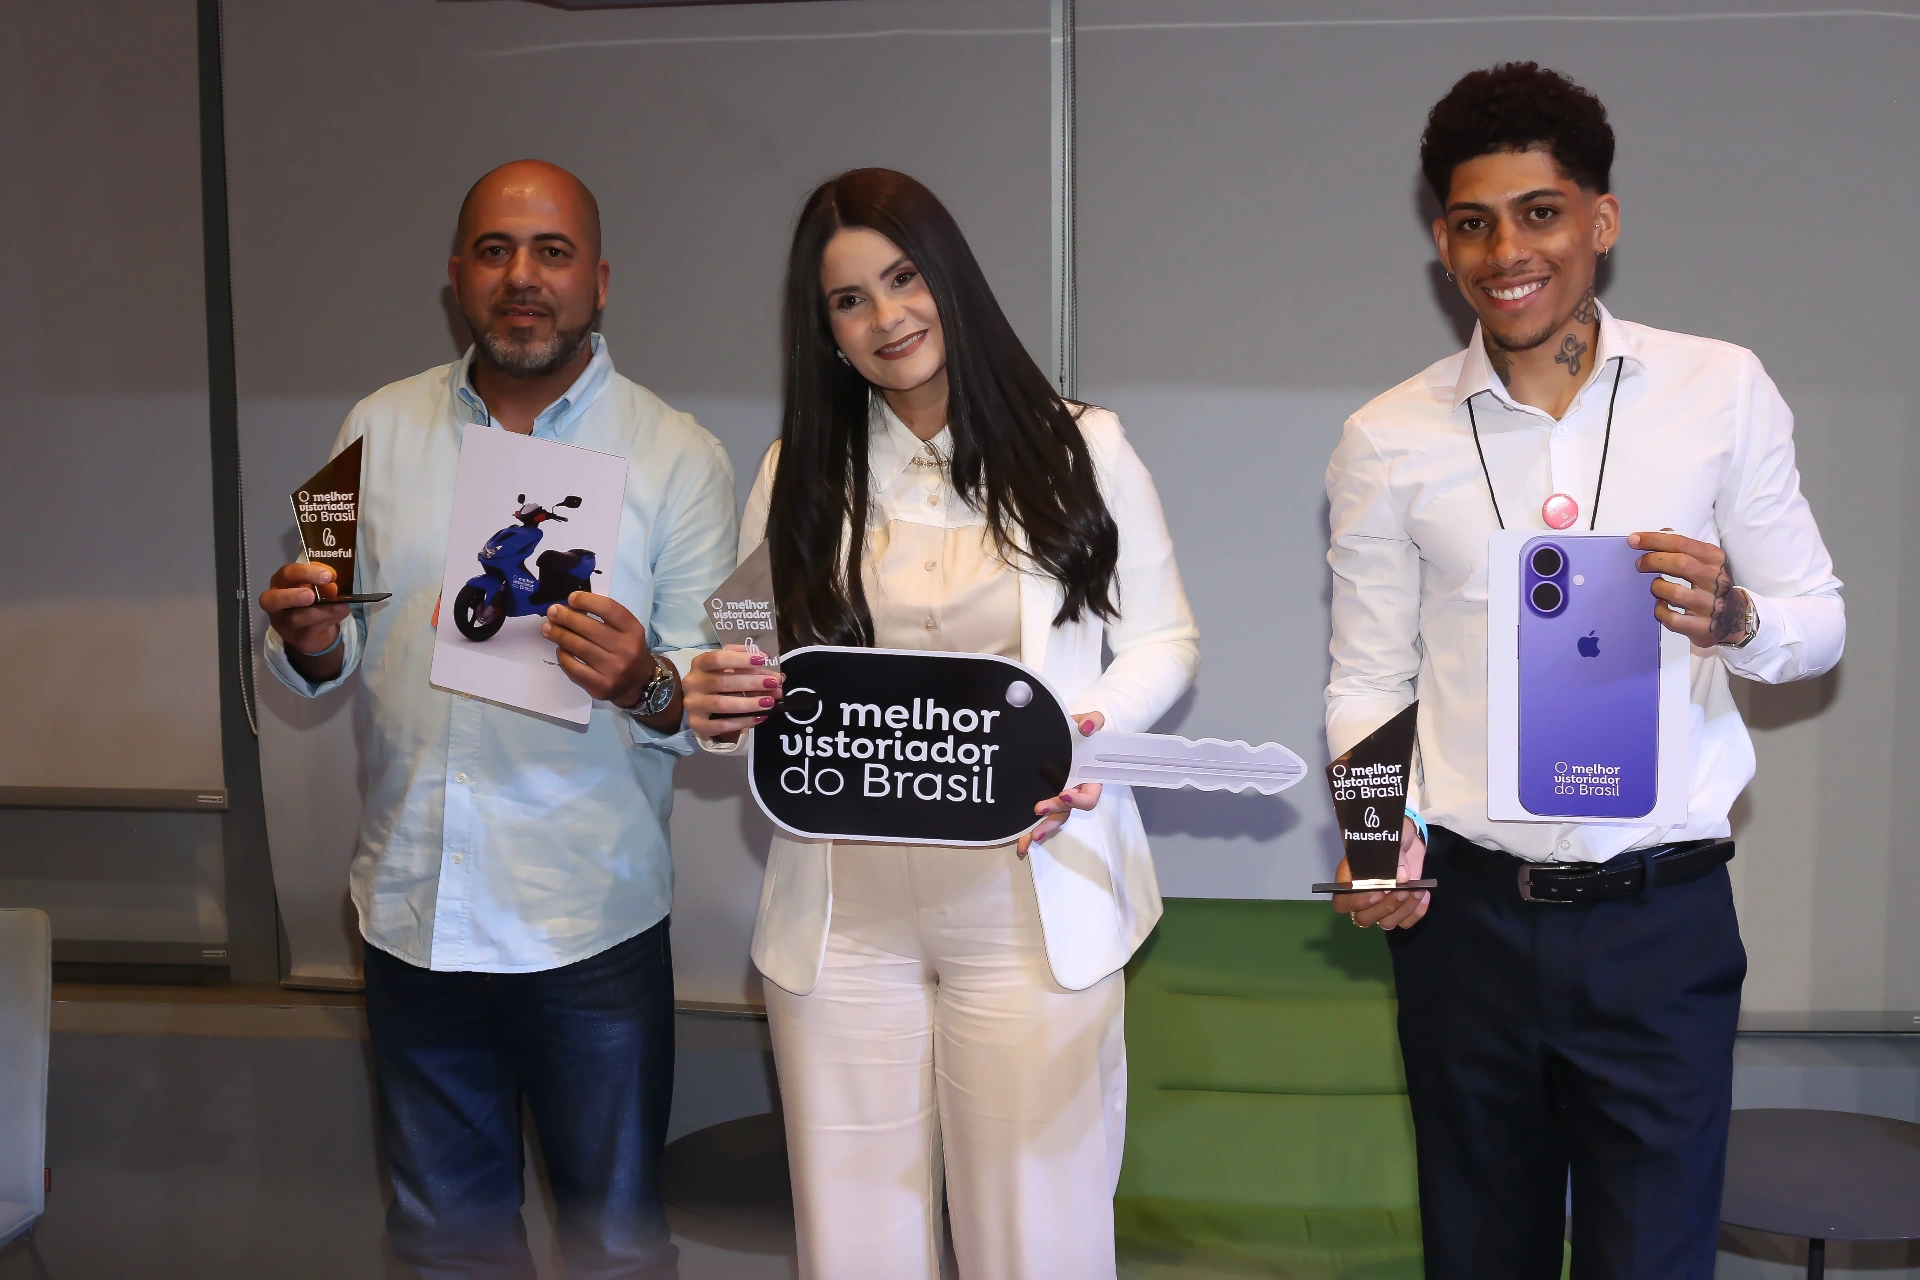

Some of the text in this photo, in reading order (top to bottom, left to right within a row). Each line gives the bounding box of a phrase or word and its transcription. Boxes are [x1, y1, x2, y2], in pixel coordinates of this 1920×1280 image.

[298, 490, 354, 503] O melhor
[299, 501, 355, 512] vistoriador
[300, 509, 357, 523] do Brasil
[308, 547, 352, 559] hauseful
[711, 597, 769, 610] O melhor
[712, 609, 771, 619] vistoriador
[715, 617, 774, 631] do Brasil
[784, 687, 1001, 733] O melhor
[779, 726, 1000, 765] vistoriador
[1332, 762, 1402, 778] O melhor
[1554, 761, 1621, 775] O melhor
[780, 757, 995, 804] do Brasil
[1332, 773, 1404, 788] vistoriador
[1553, 773, 1621, 785] vistoriador
[1334, 782, 1404, 801] do Brasil
[1554, 782, 1620, 797] do Brasil
[1344, 828, 1399, 842] hauseful
